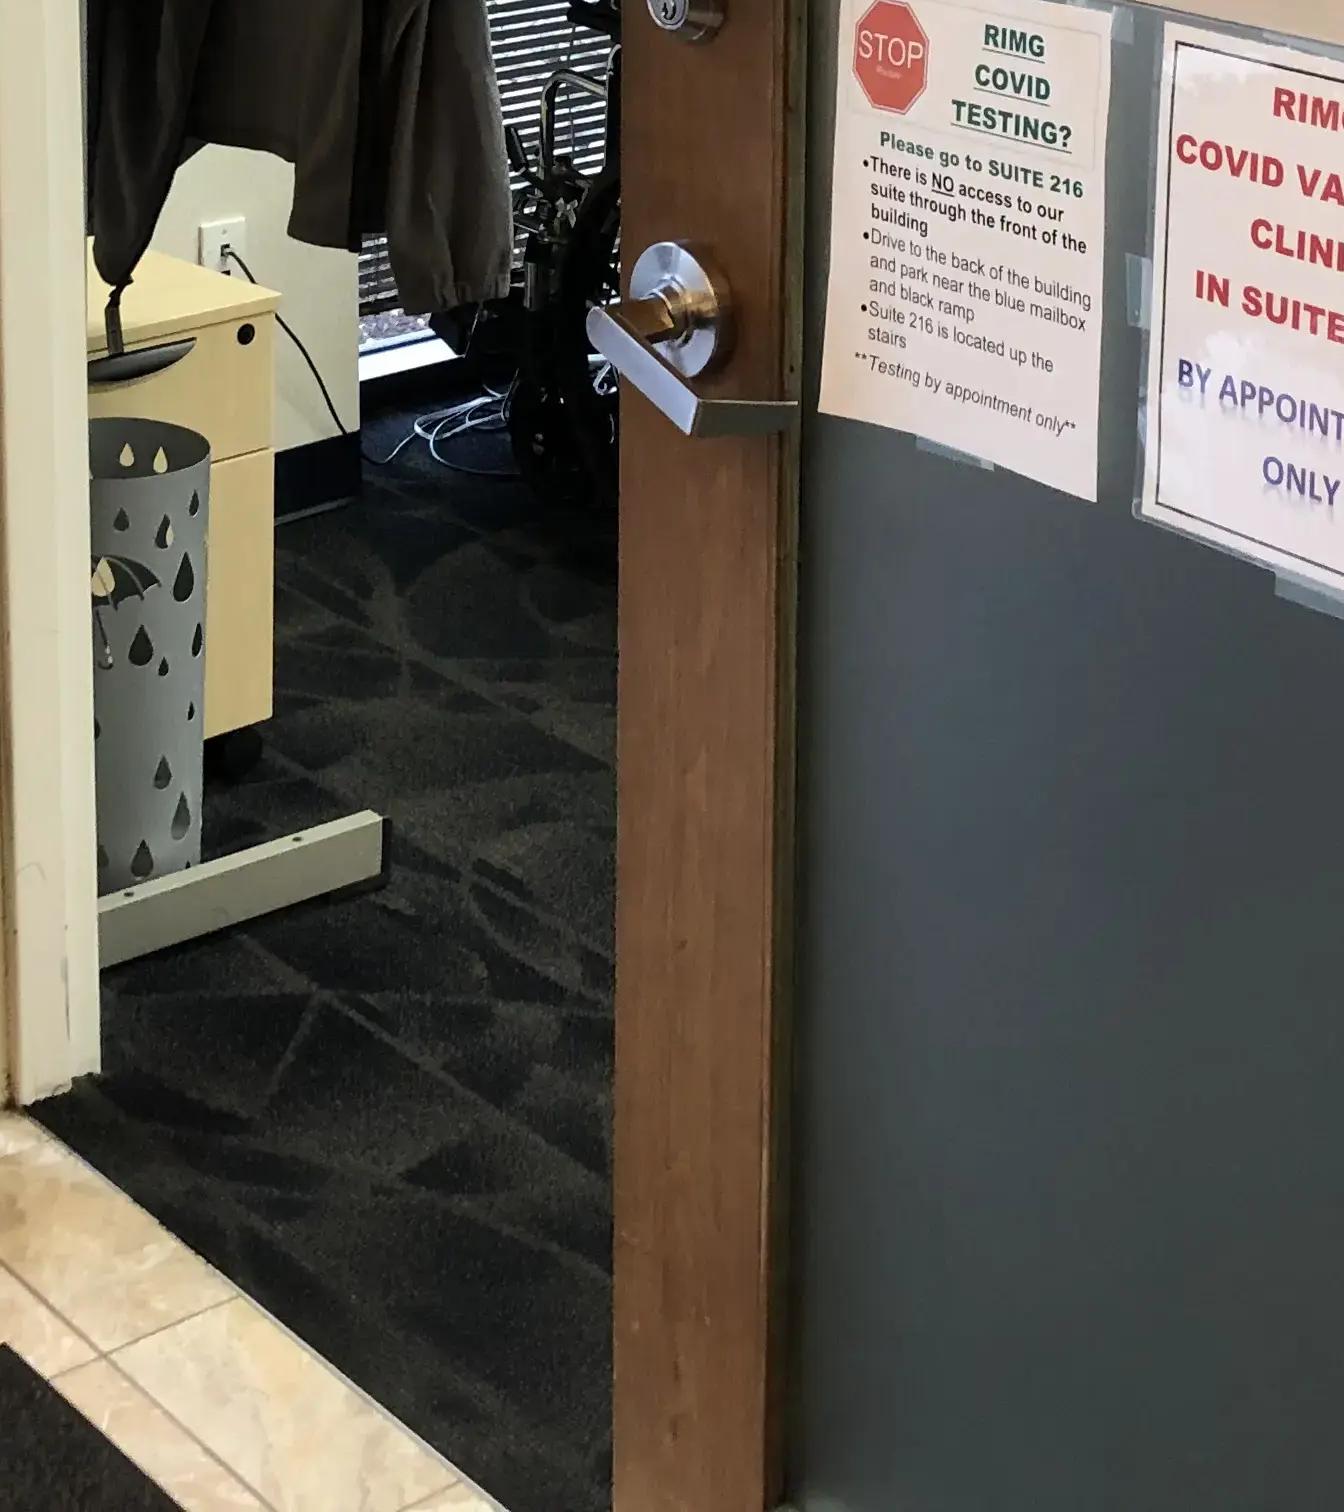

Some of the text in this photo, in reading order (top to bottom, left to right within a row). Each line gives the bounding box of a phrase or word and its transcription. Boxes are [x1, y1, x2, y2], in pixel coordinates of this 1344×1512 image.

[858, 29, 924, 69] STOP
[983, 23, 1046, 58] RIMG
[974, 63, 1051, 101] COVID
[951, 99, 1072, 148] TESTING?
[880, 131, 1084, 199] Please go to SUITE 216
[1176, 133, 1284, 188] COVID
[870, 156, 1065, 223] There is NO access to our
[870, 182, 1087, 254] suite through the front of the
[871, 203, 928, 238] building
[870, 253, 1087, 332] and park near the blue mailbox
[871, 227, 1092, 312] Drive to the back of the building
[1195, 270, 1230, 308] IN
[869, 277, 975, 322] and black ramp
[868, 326, 907, 348] stairs
[869, 300, 1054, 373] Suite 216 is located up the
[925, 370, 941, 393] by
[945, 379, 1032, 423] appointment
[1177, 358, 1211, 394] BY
[1262, 455, 1341, 506] ONLY
